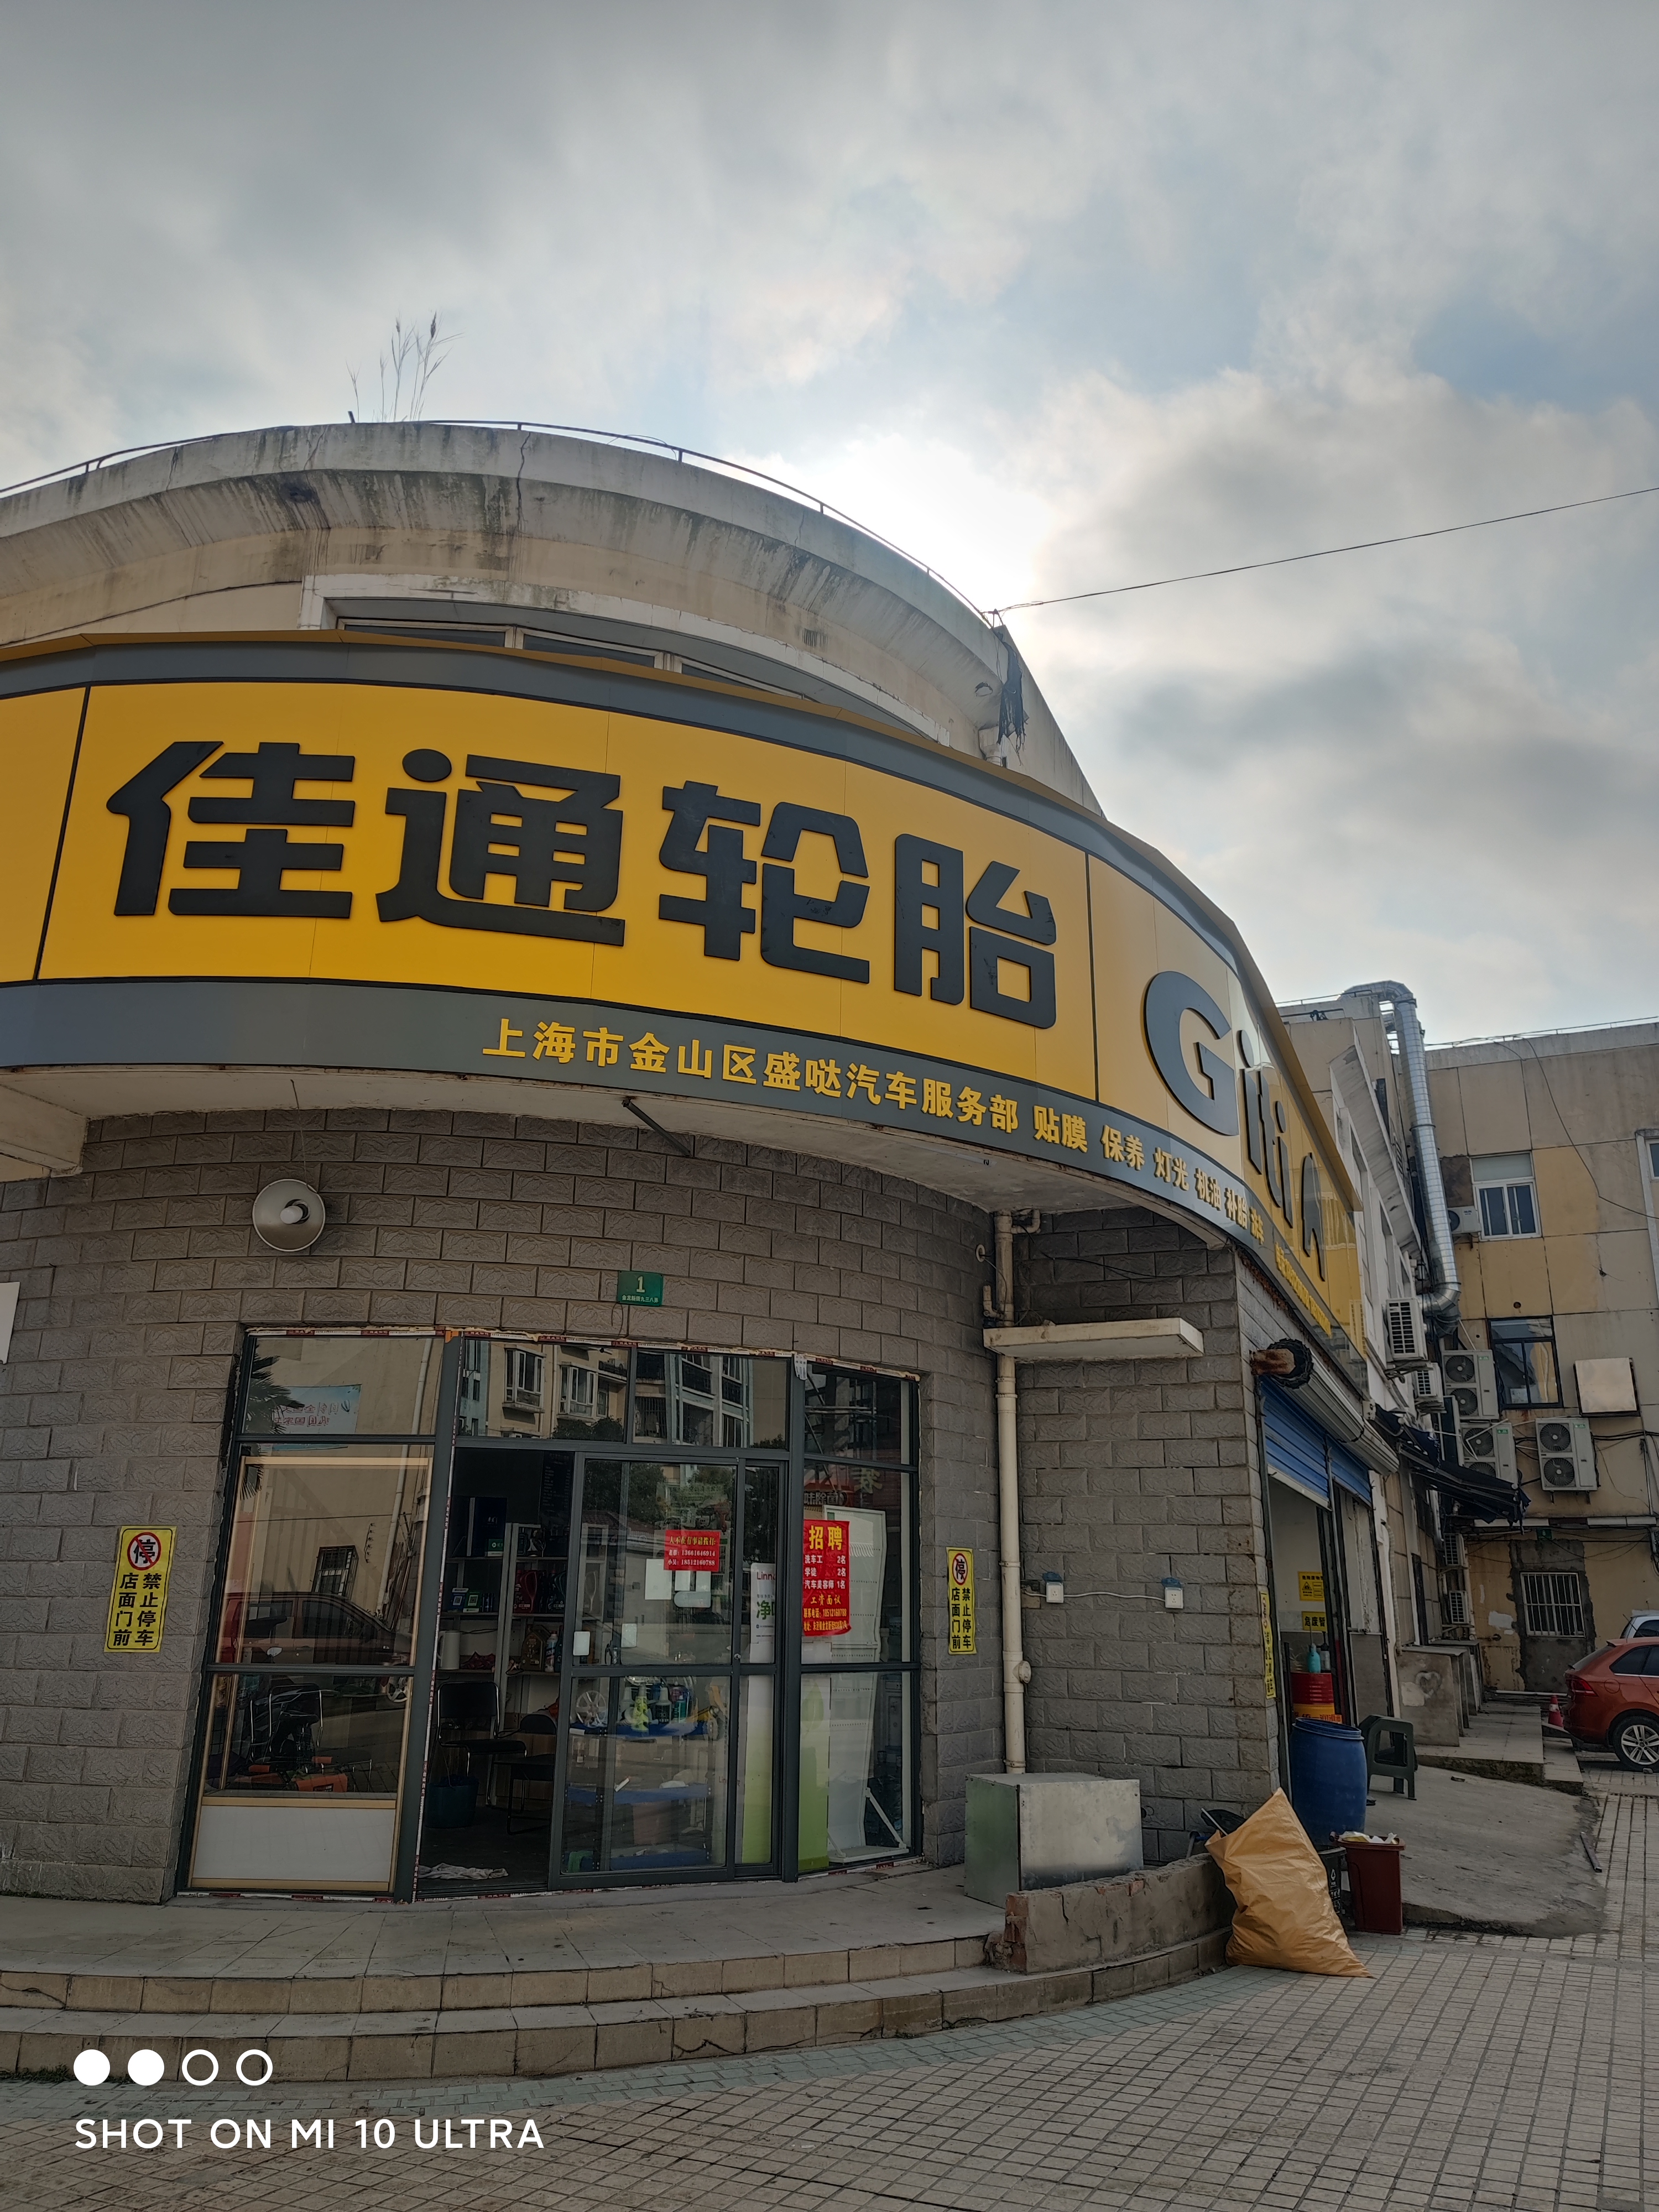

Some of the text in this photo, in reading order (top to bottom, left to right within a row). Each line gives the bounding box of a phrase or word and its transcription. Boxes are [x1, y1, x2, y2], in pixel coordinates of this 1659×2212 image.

[106, 741, 1056, 1029] 佳通轮胎
[482, 1018, 1264, 1245] 上海市金山区盛哒汽车服务部 贴膜 保养 灯光 机油 补胎 洗车
[637, 1276, 645, 1293] 1
[808, 1525, 843, 1551] 招聘
[133, 1539, 156, 1564] 停
[805, 1554, 846, 1564] 洗车工 2名
[805, 1567, 846, 1577] 学徒 2名
[805, 1579, 846, 1589] 汽车美容师 1名
[113, 1573, 139, 1646] 店面门前
[135, 1573, 162, 1646] 禁止停车
[810, 1594, 841, 1606] 工资面议
[951, 1587, 961, 1649] 店面门前
[962, 1587, 972, 1649] 禁止停车
